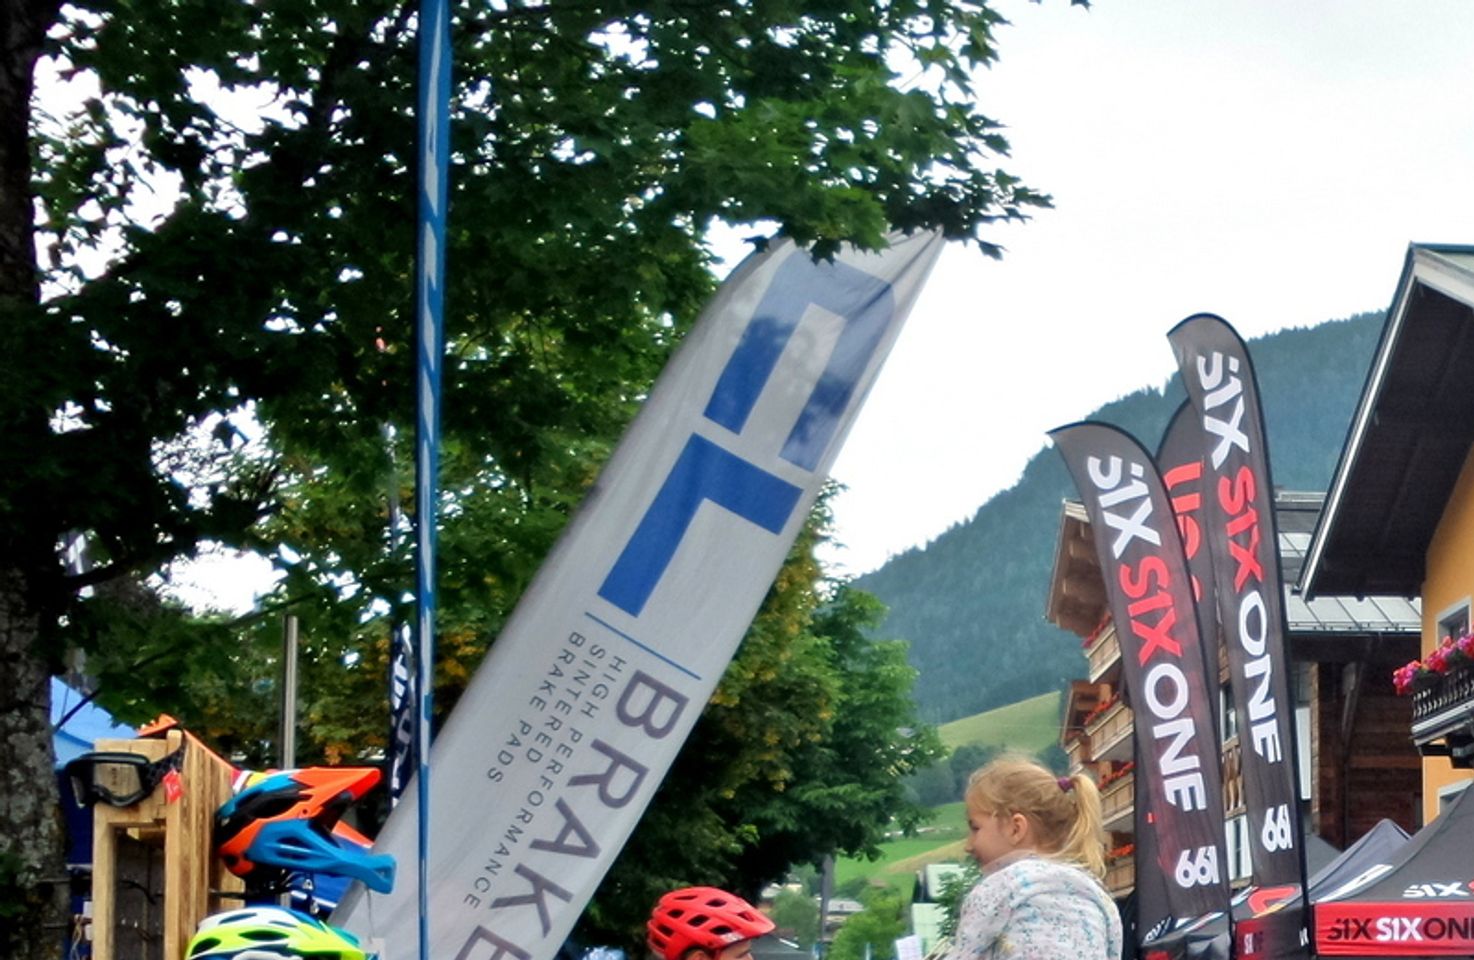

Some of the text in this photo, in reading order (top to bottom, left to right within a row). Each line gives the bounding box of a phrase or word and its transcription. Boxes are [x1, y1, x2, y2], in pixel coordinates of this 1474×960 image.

[1087, 454, 1162, 560] SIX
[1197, 350, 1280, 764] SIX SIX ONE
[1120, 556, 1183, 665] SIX
[487, 631, 586, 783] BRAKE PADS
[527, 644, 605, 762] SINTERED
[1144, 664, 1206, 813] ONE
[464, 656, 627, 908] HIGH PERFORMANCE
[1261, 805, 1292, 853] 661
[1175, 845, 1219, 888] 661
[1403, 881, 1469, 897] SIX
[1327, 917, 1372, 940] SIX
[1376, 917, 1424, 941] SIX
